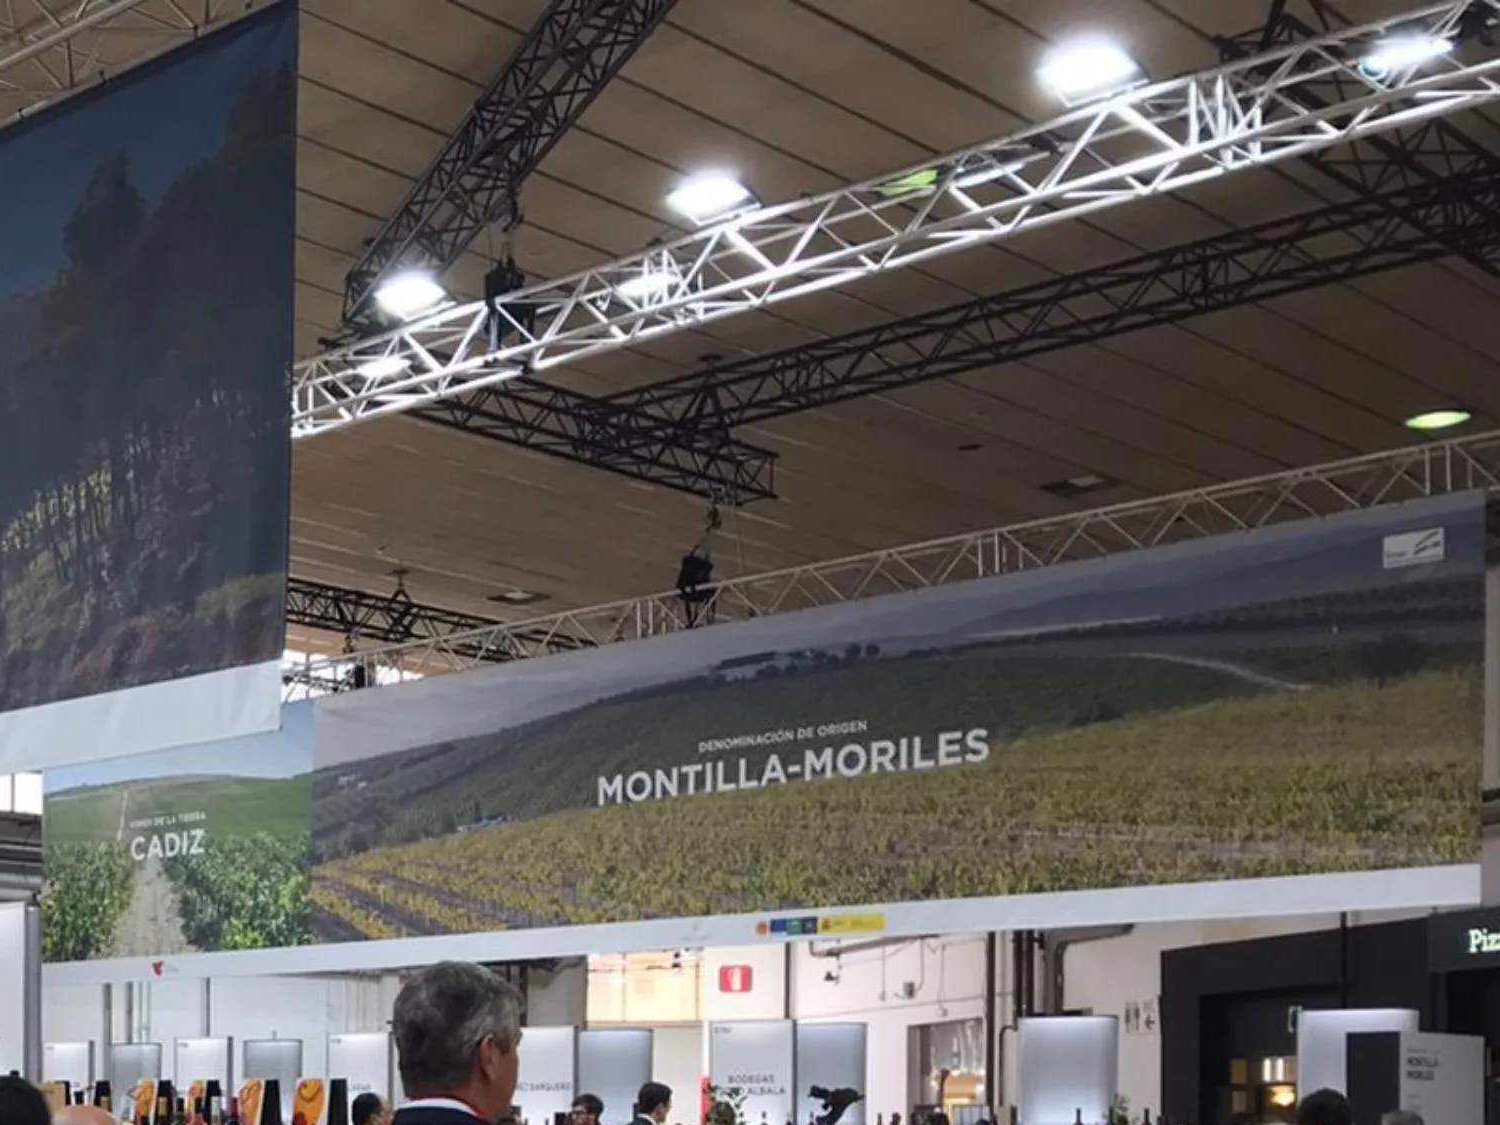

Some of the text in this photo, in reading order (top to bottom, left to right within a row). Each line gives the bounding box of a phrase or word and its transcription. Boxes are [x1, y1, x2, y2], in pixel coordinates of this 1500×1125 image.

[698, 720, 868, 753] DENOMINACIÓN DE ORIGEN
[597, 728, 990, 807] MONTILLA-MORILES
